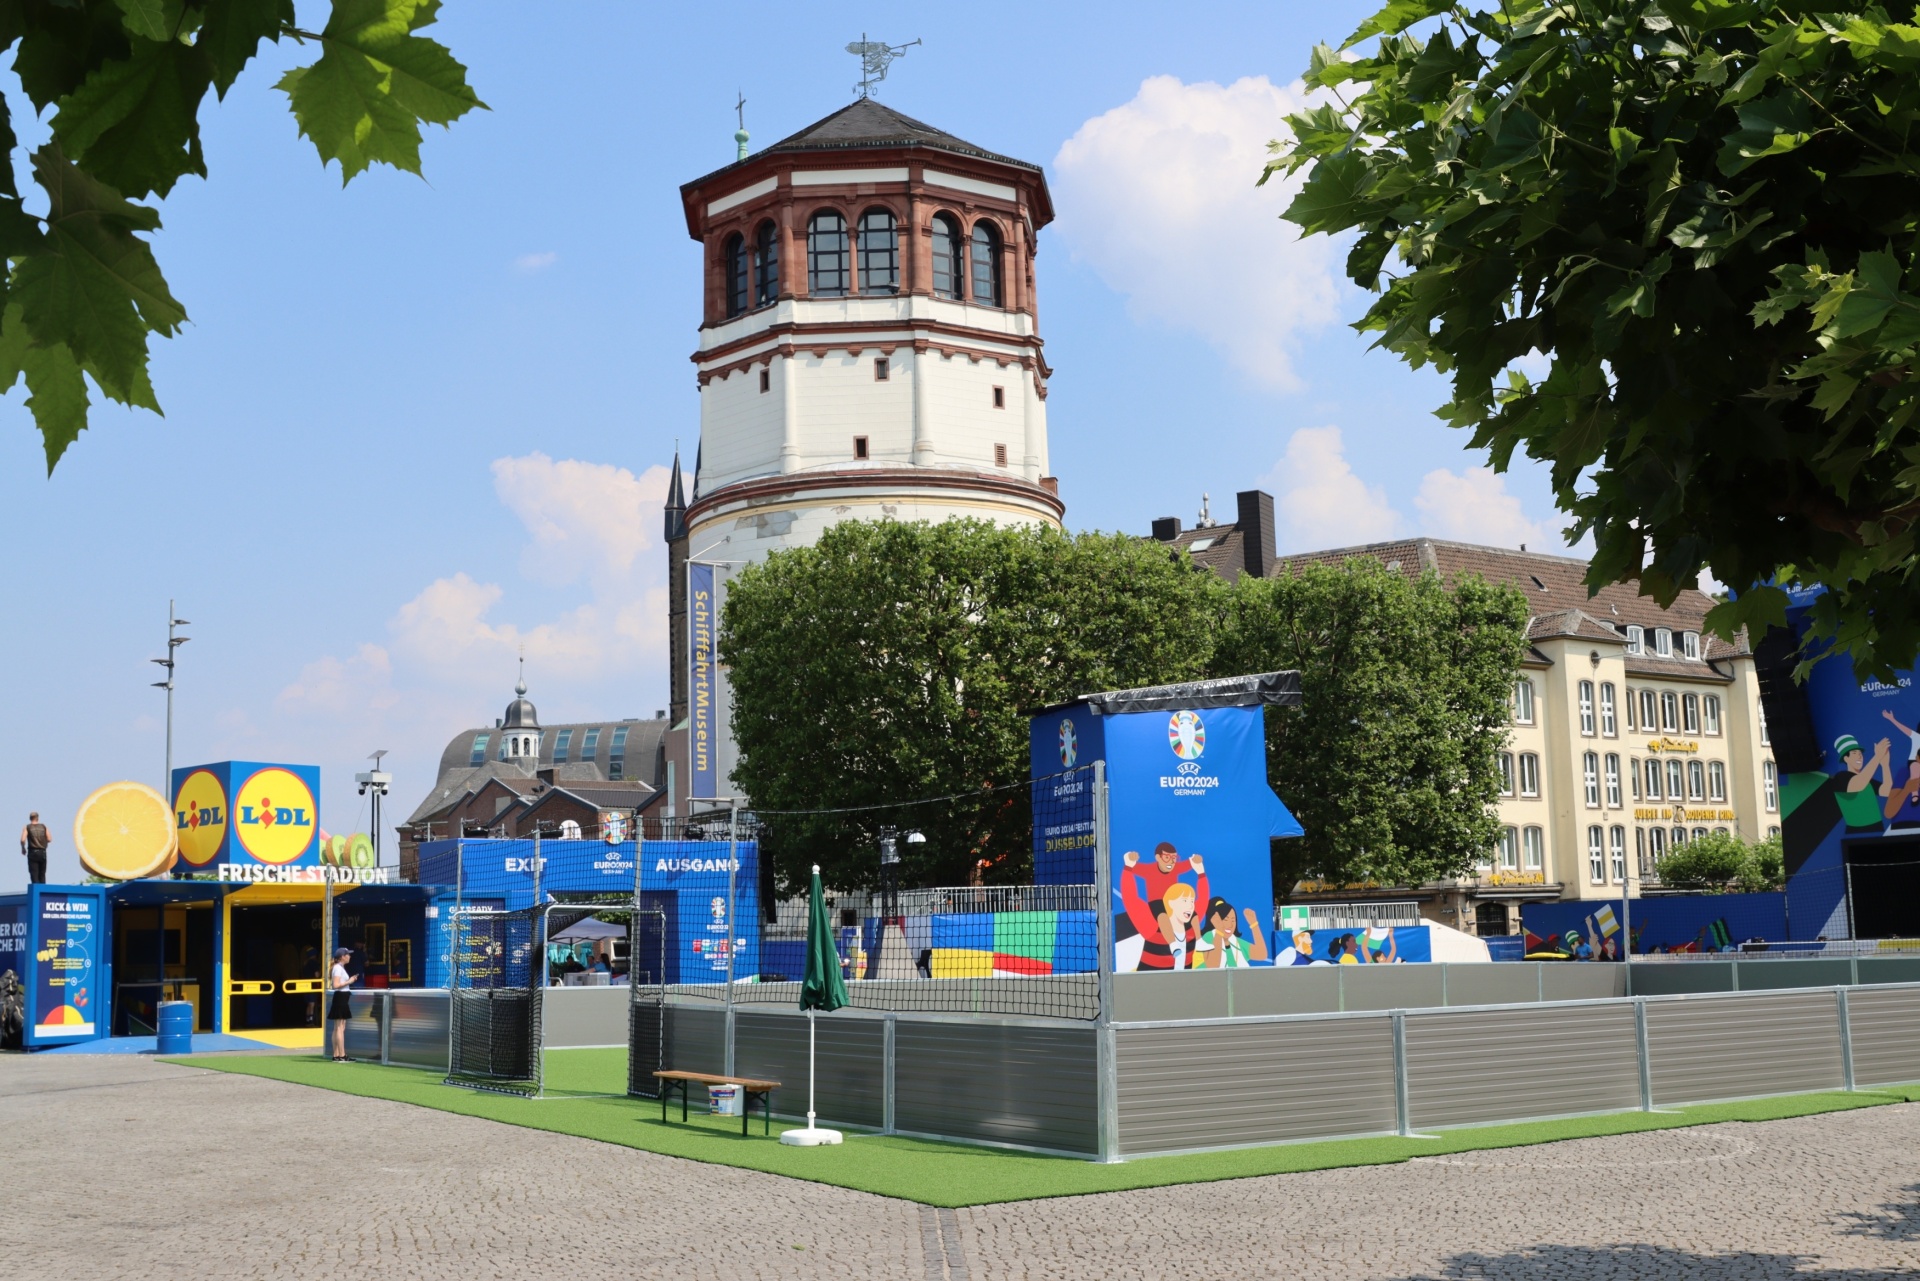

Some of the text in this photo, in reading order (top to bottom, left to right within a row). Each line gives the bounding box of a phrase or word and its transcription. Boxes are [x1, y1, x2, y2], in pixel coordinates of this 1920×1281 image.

[694, 590, 709, 771] SchifffahrtMuseum
[1872, 689, 1900, 698] GERMANY
[1177, 762, 1201, 775] UEFA
[1160, 776, 1219, 788] EURO2024
[1046, 833, 1095, 852] DÜSSELDOR
[505, 857, 547, 872] EXIT
[593, 861, 633, 869] EURO2024
[656, 858, 740, 872] AUSGANG
[218, 863, 388, 885] FRISCHE STADION
[46, 902, 65, 911] KICK
[72, 903, 88, 912] WIN
[15, 938, 26, 951] IN
